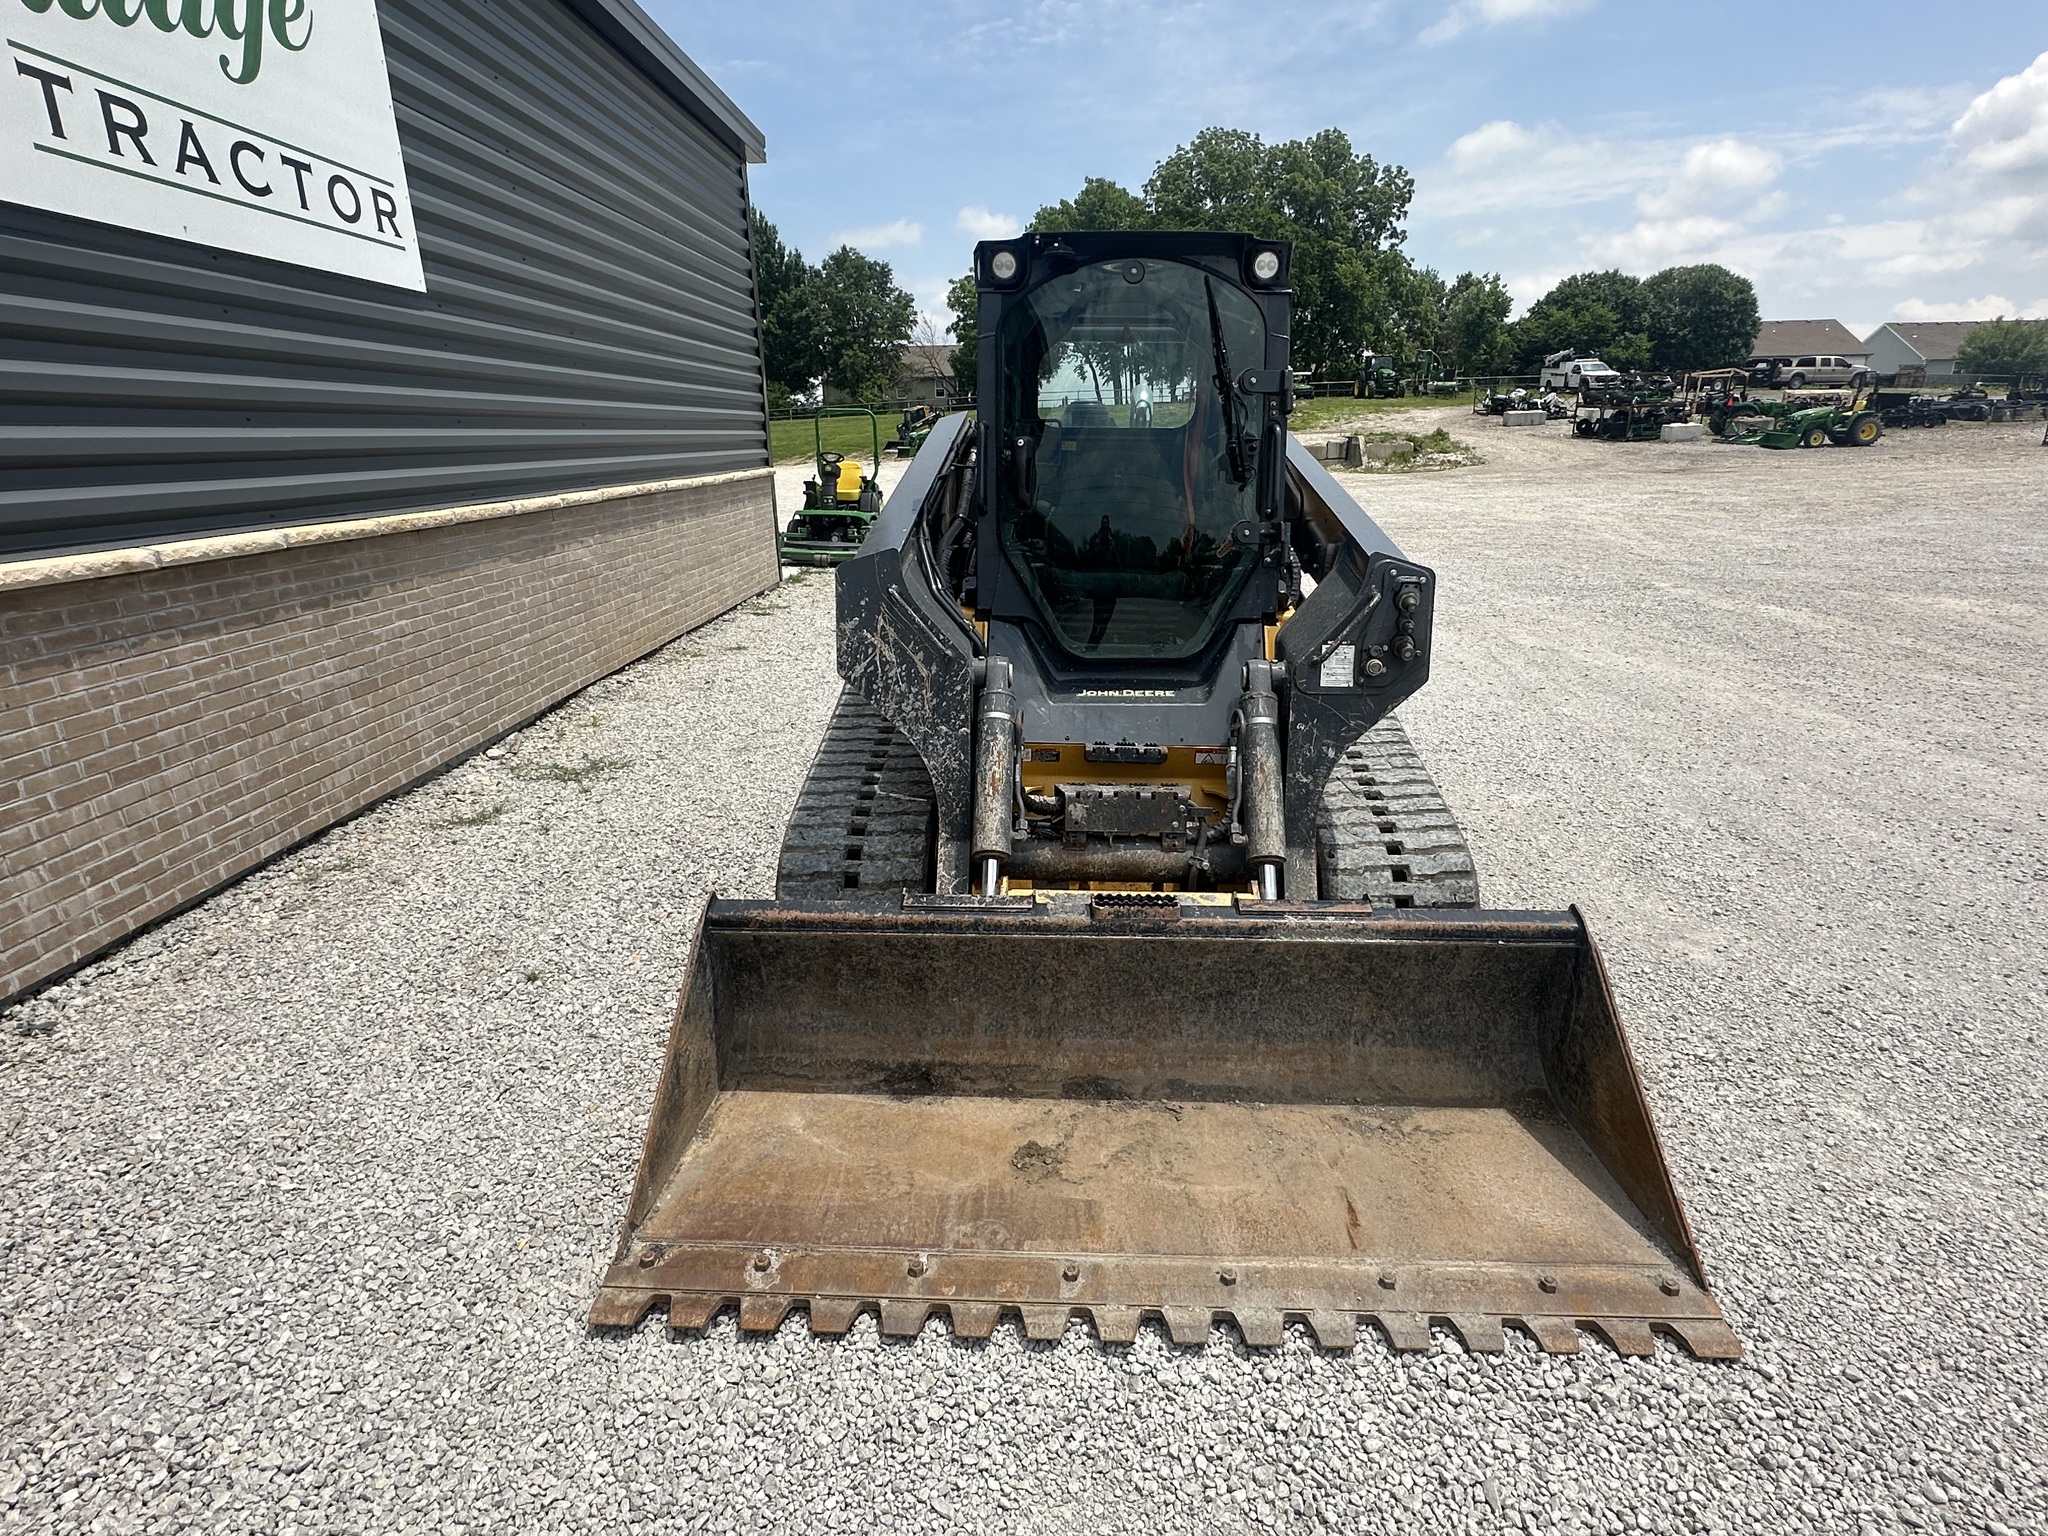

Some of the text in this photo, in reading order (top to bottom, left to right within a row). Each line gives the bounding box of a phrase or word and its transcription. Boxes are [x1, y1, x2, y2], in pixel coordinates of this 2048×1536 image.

[14, 56, 403, 239] TRACTOR
[1076, 689, 1175, 697] JOHN DEERE
